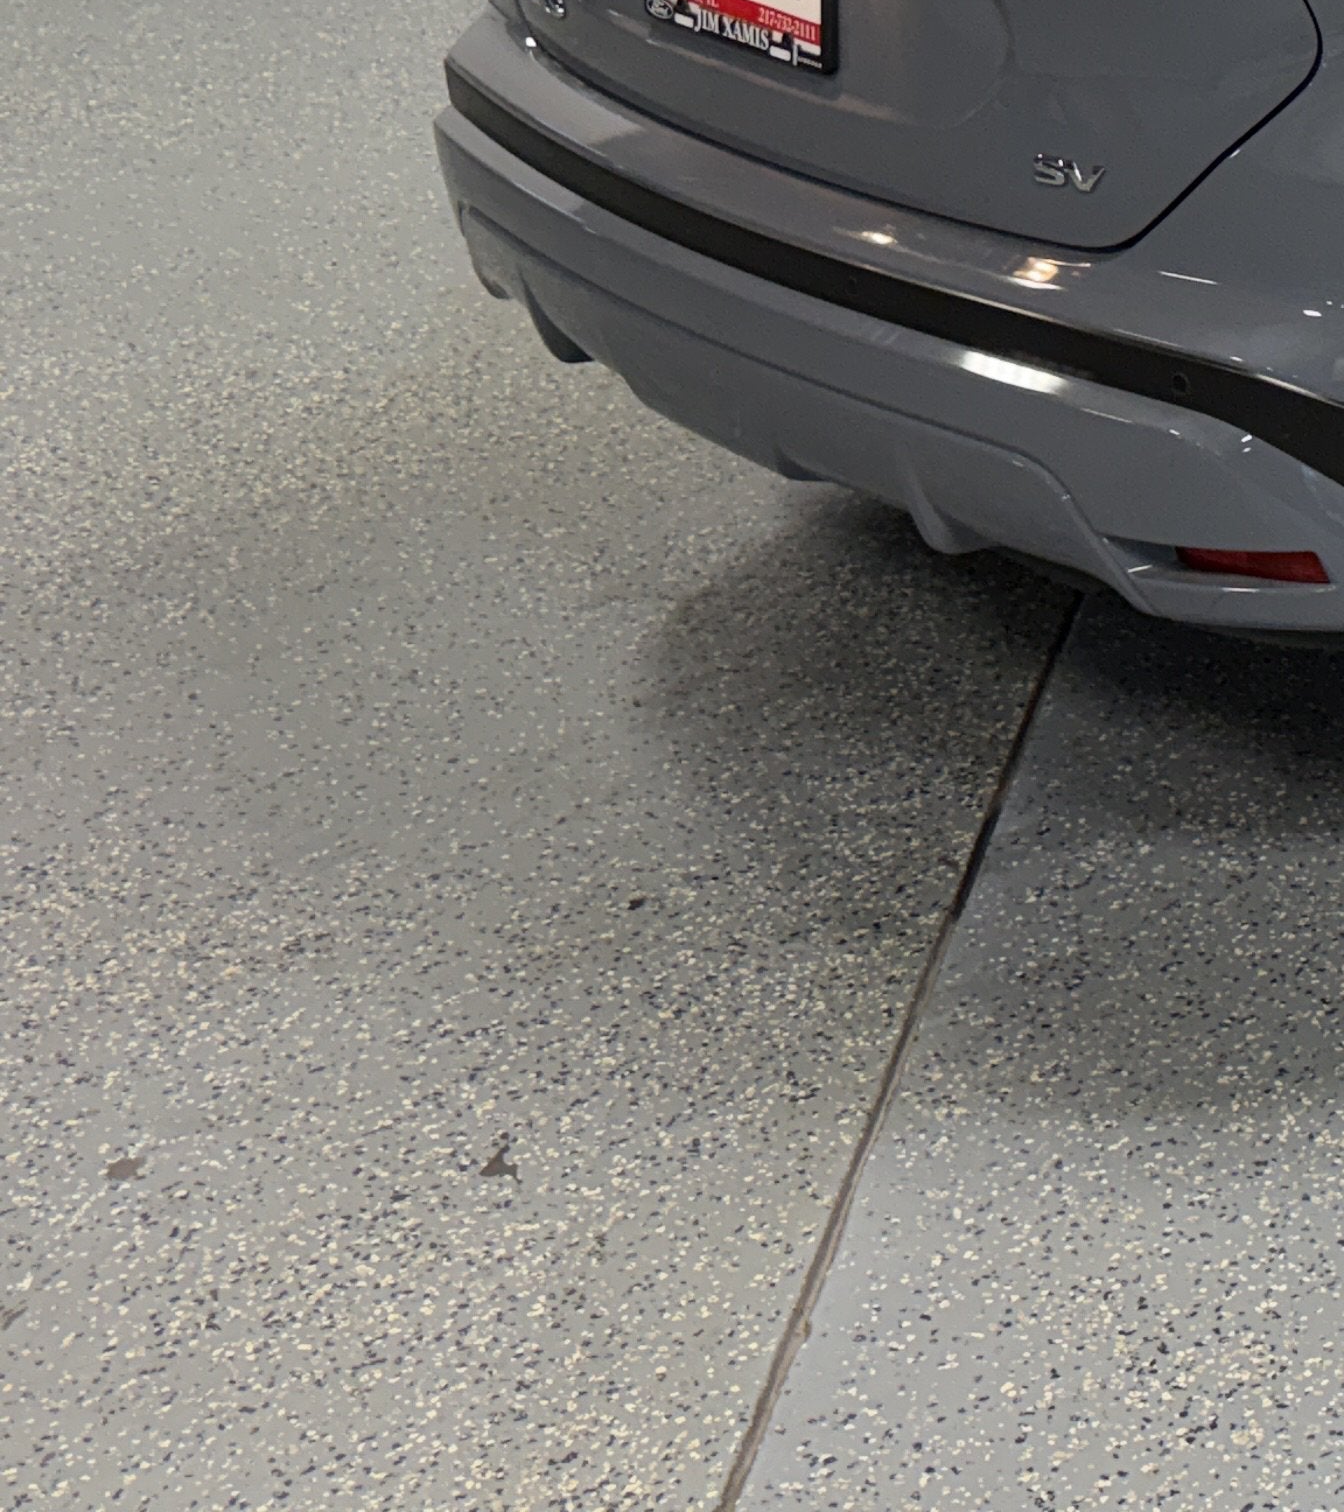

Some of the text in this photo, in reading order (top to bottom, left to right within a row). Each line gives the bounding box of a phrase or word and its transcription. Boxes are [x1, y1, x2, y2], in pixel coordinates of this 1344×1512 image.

[694, 7, 720, 32] JIM
[722, 14, 769, 50] XAMIS
[1032, 154, 1105, 193] SV
